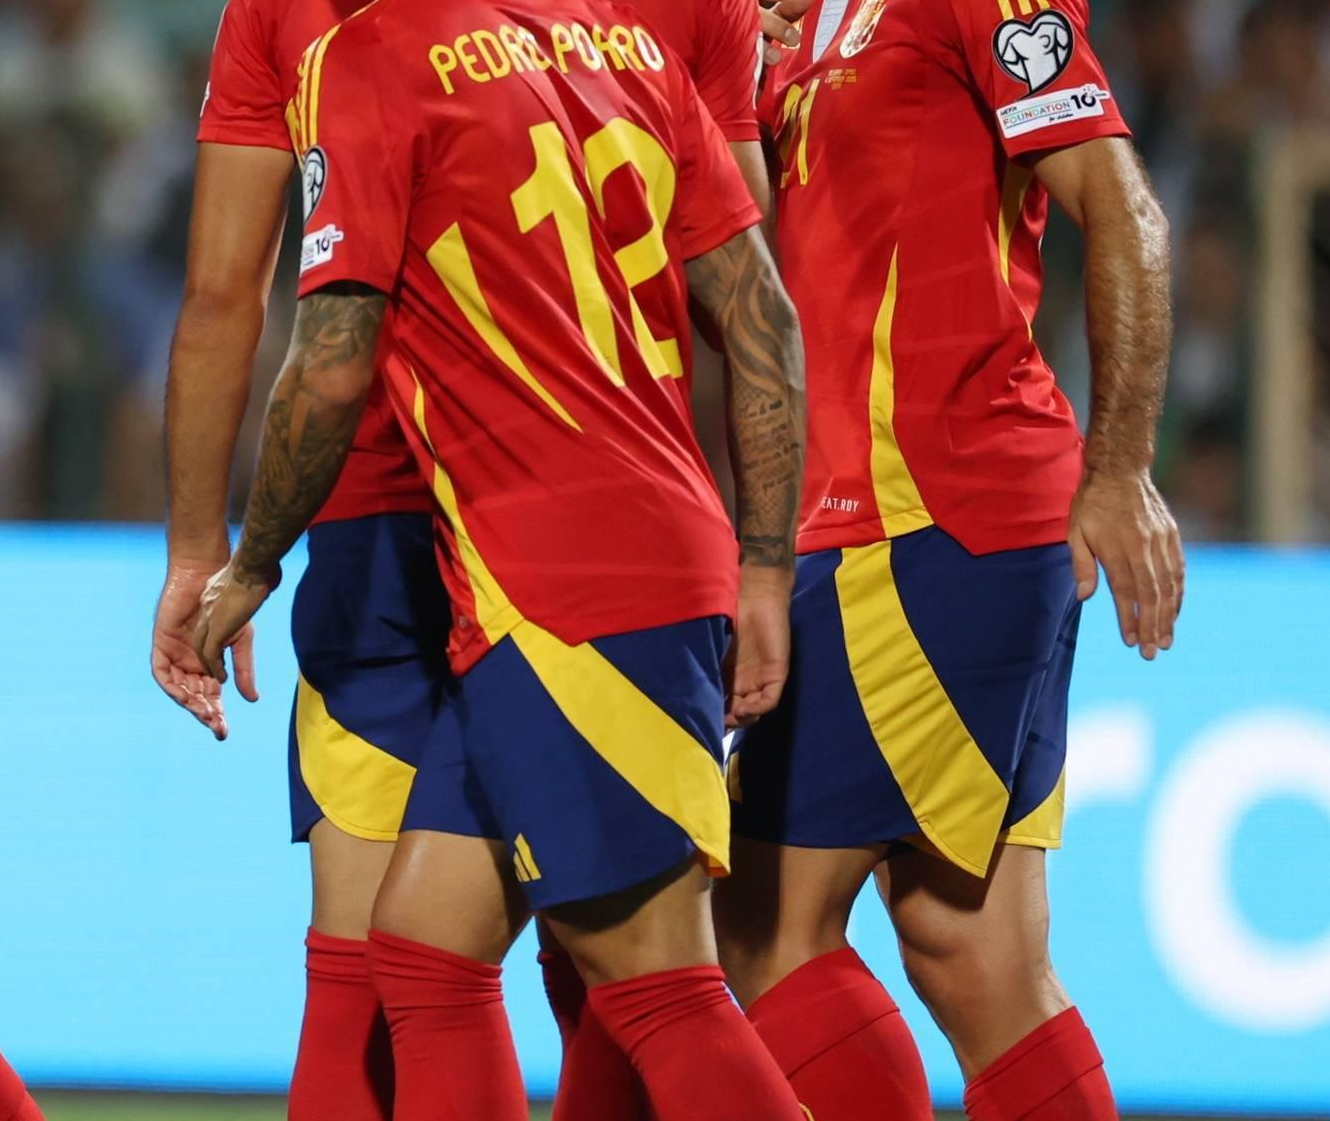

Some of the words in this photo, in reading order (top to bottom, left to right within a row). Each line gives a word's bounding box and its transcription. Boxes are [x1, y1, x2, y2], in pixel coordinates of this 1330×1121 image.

[429, 23, 553, 95] PEDRO
[1003, 101, 1071, 127] FOUNDATION
[509, 116, 684, 389] 12
